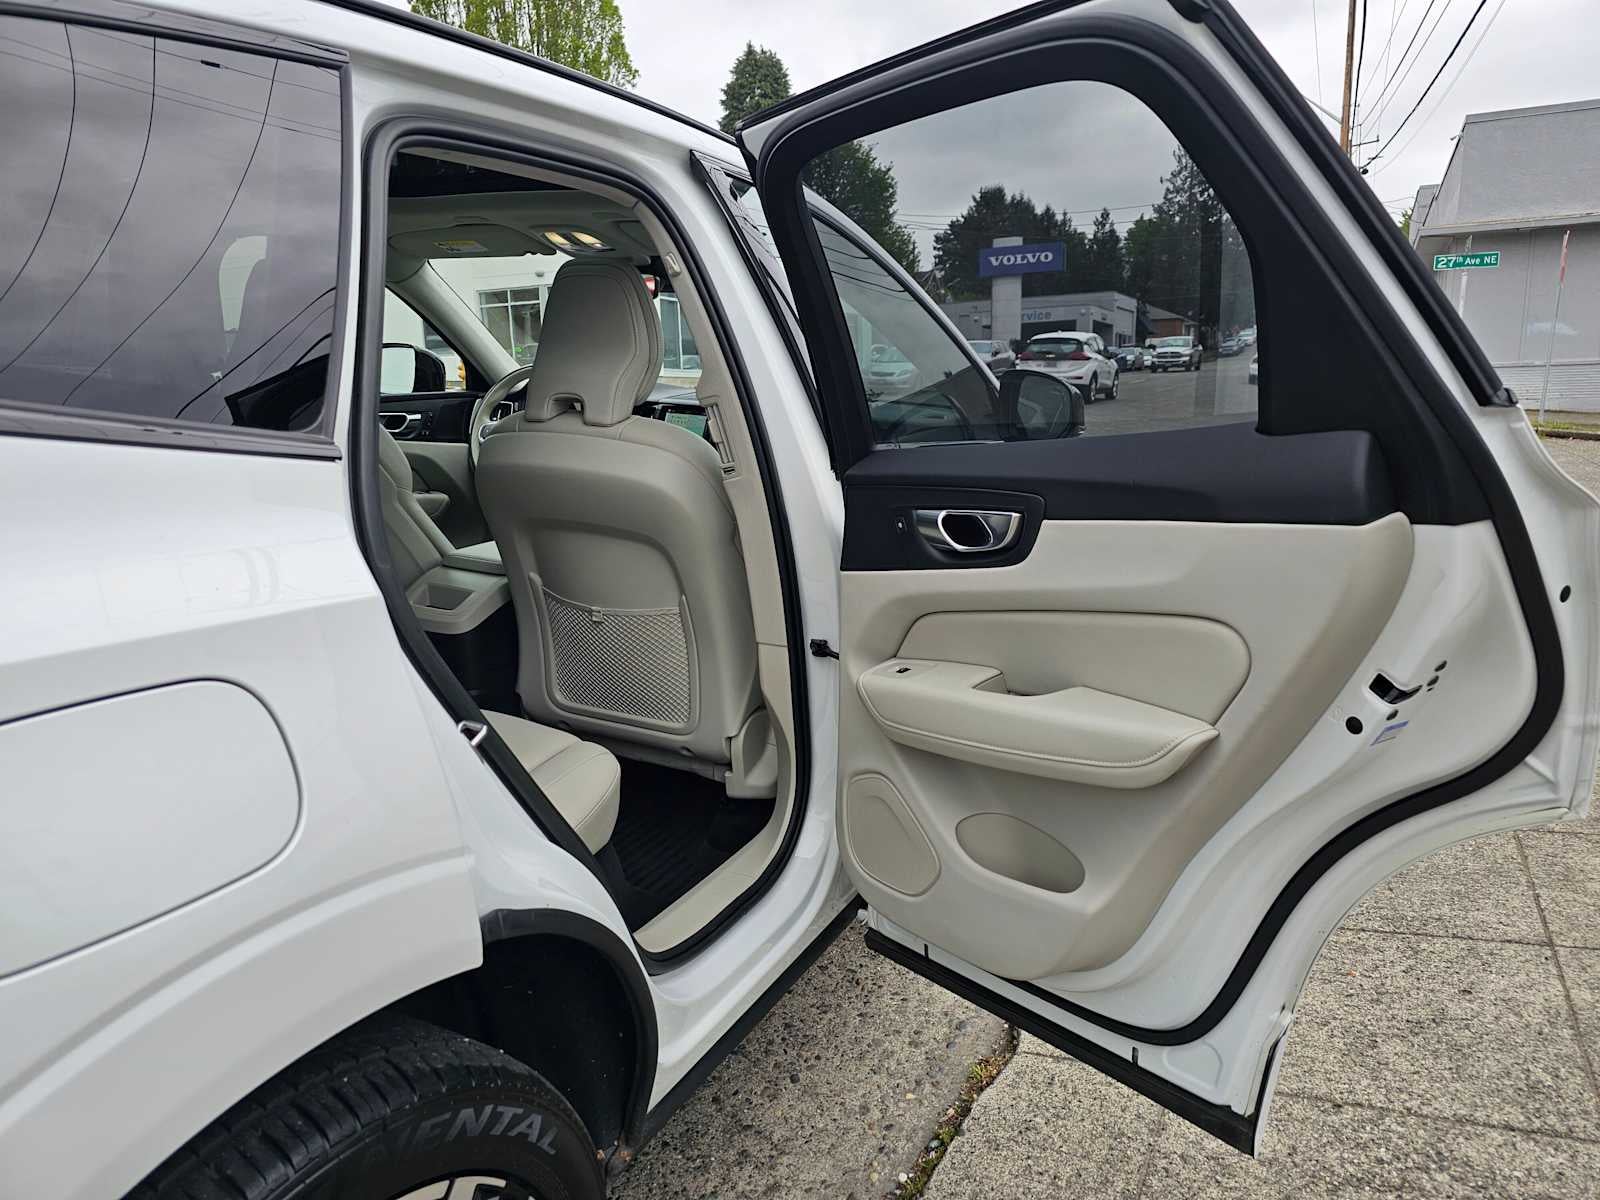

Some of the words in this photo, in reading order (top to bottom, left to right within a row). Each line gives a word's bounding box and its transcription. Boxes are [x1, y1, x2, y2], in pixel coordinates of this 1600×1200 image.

[988, 251, 1053, 267] VOLVO
[1437, 256, 1464, 268] 27th
[1465, 257, 1480, 265] Ave
[1483, 255, 1497, 264] NE
[1022, 310, 1052, 321] rvice
